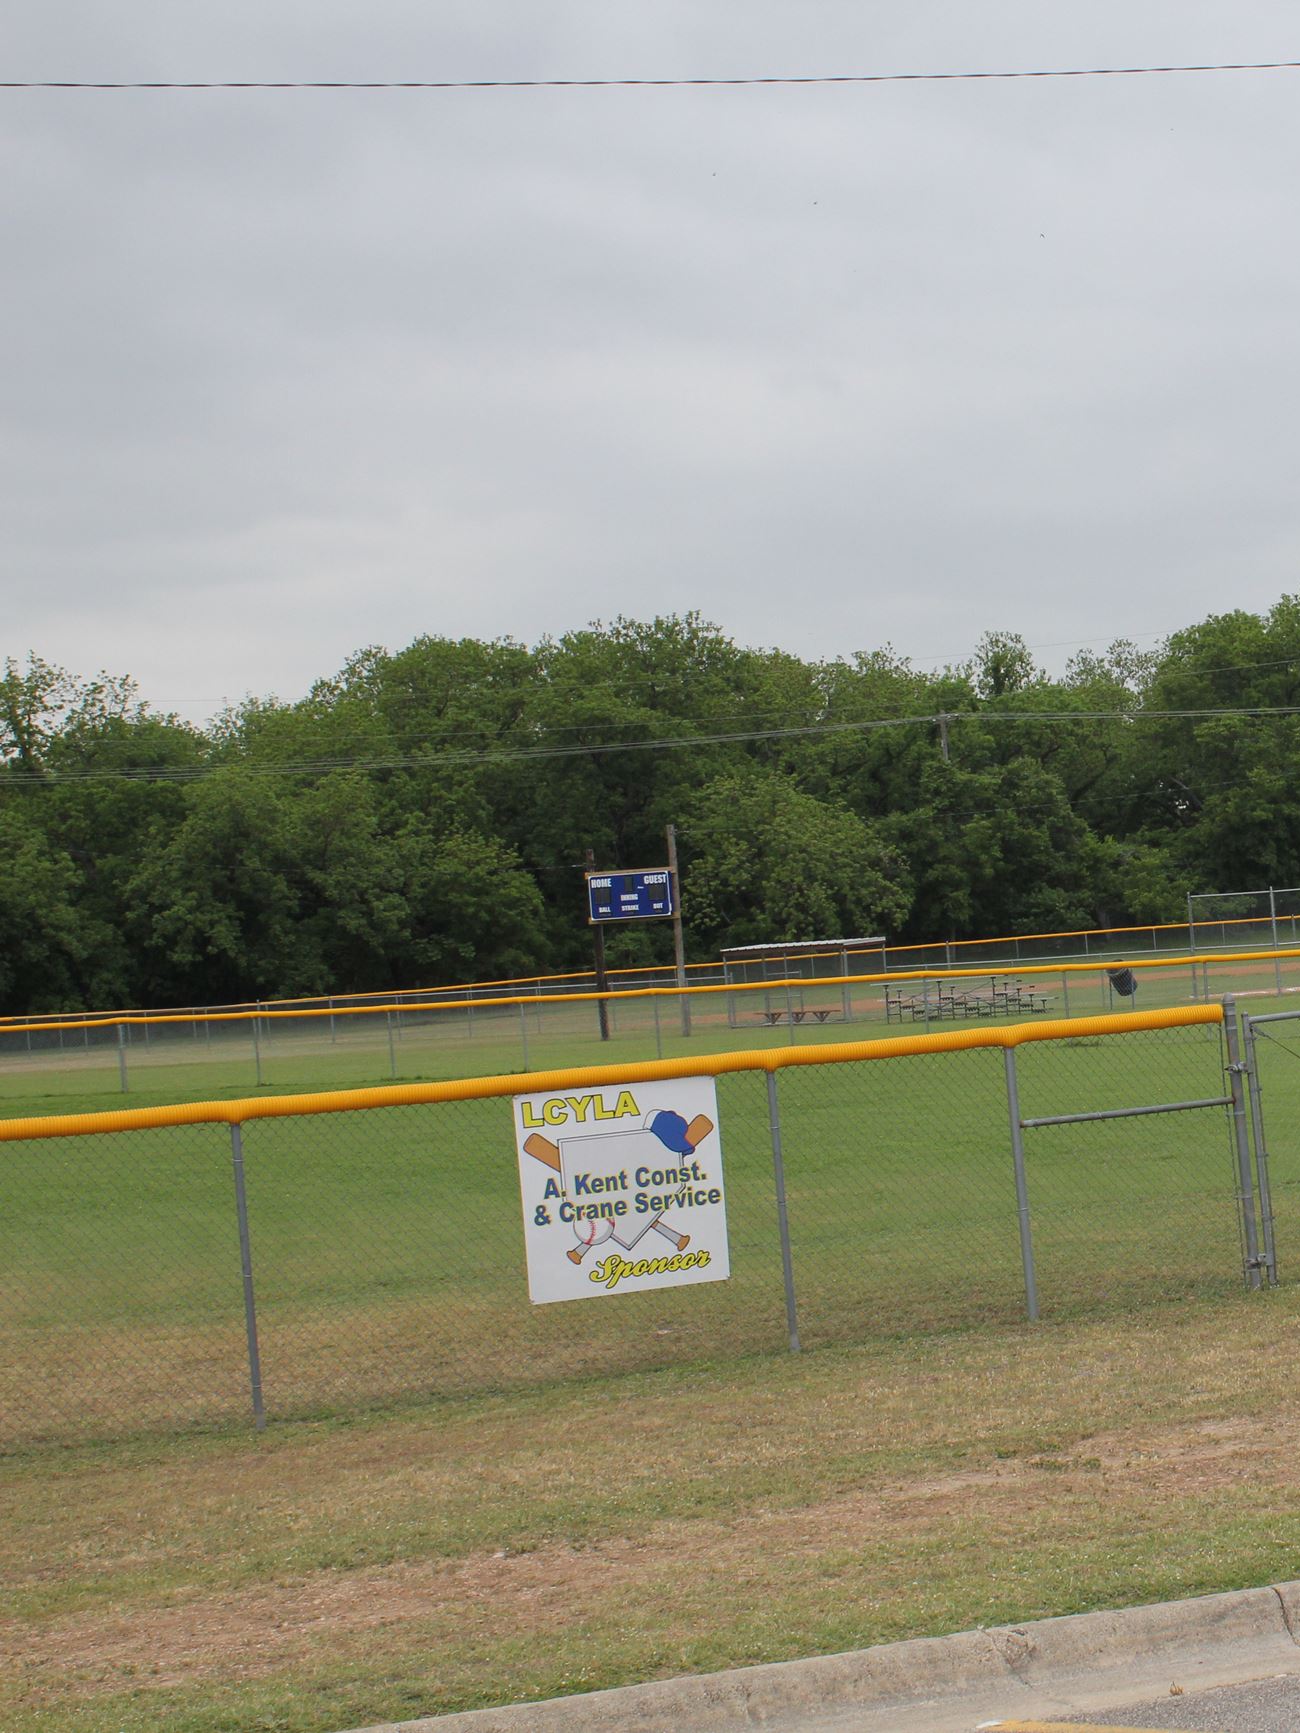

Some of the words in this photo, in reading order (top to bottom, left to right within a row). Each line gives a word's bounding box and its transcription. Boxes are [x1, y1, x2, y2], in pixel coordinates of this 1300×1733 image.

[591, 878, 612, 888] HOME
[643, 874, 667, 884] GUEST
[521, 1091, 640, 1128] LCYLA
[544, 1178, 566, 1199] A.
[574, 1169, 628, 1195] Kent
[635, 1161, 707, 1188] Const.
[534, 1205, 551, 1226] &
[559, 1200, 628, 1223] Crane
[635, 1187, 721, 1214] Service
[589, 1249, 711, 1289] Sponsor
